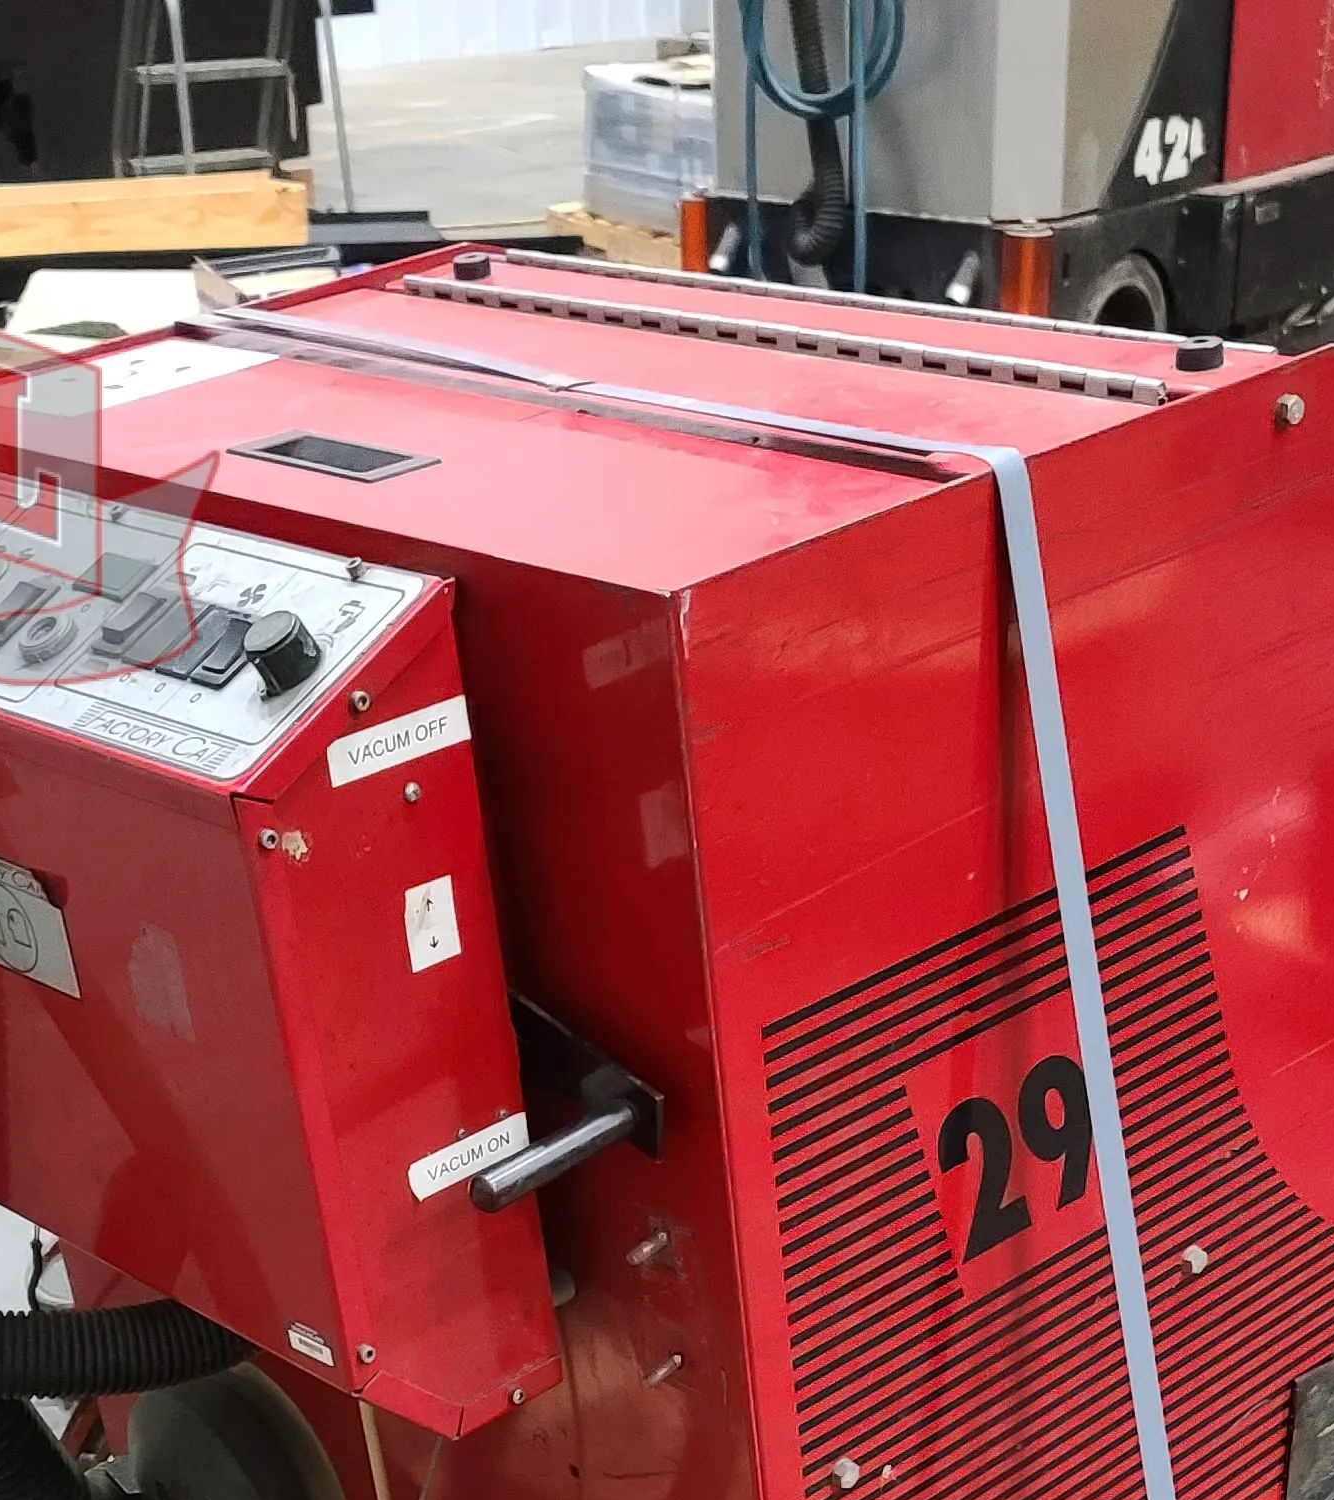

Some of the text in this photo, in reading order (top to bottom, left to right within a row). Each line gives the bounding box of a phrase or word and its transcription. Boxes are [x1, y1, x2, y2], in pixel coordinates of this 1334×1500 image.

[83, 710, 226, 765] FACTORY CAT
[347, 716, 448, 766] VACUM OFF
[427, 1132, 511, 1181] VACUM ON
[938, 1055, 1093, 1265] 29
